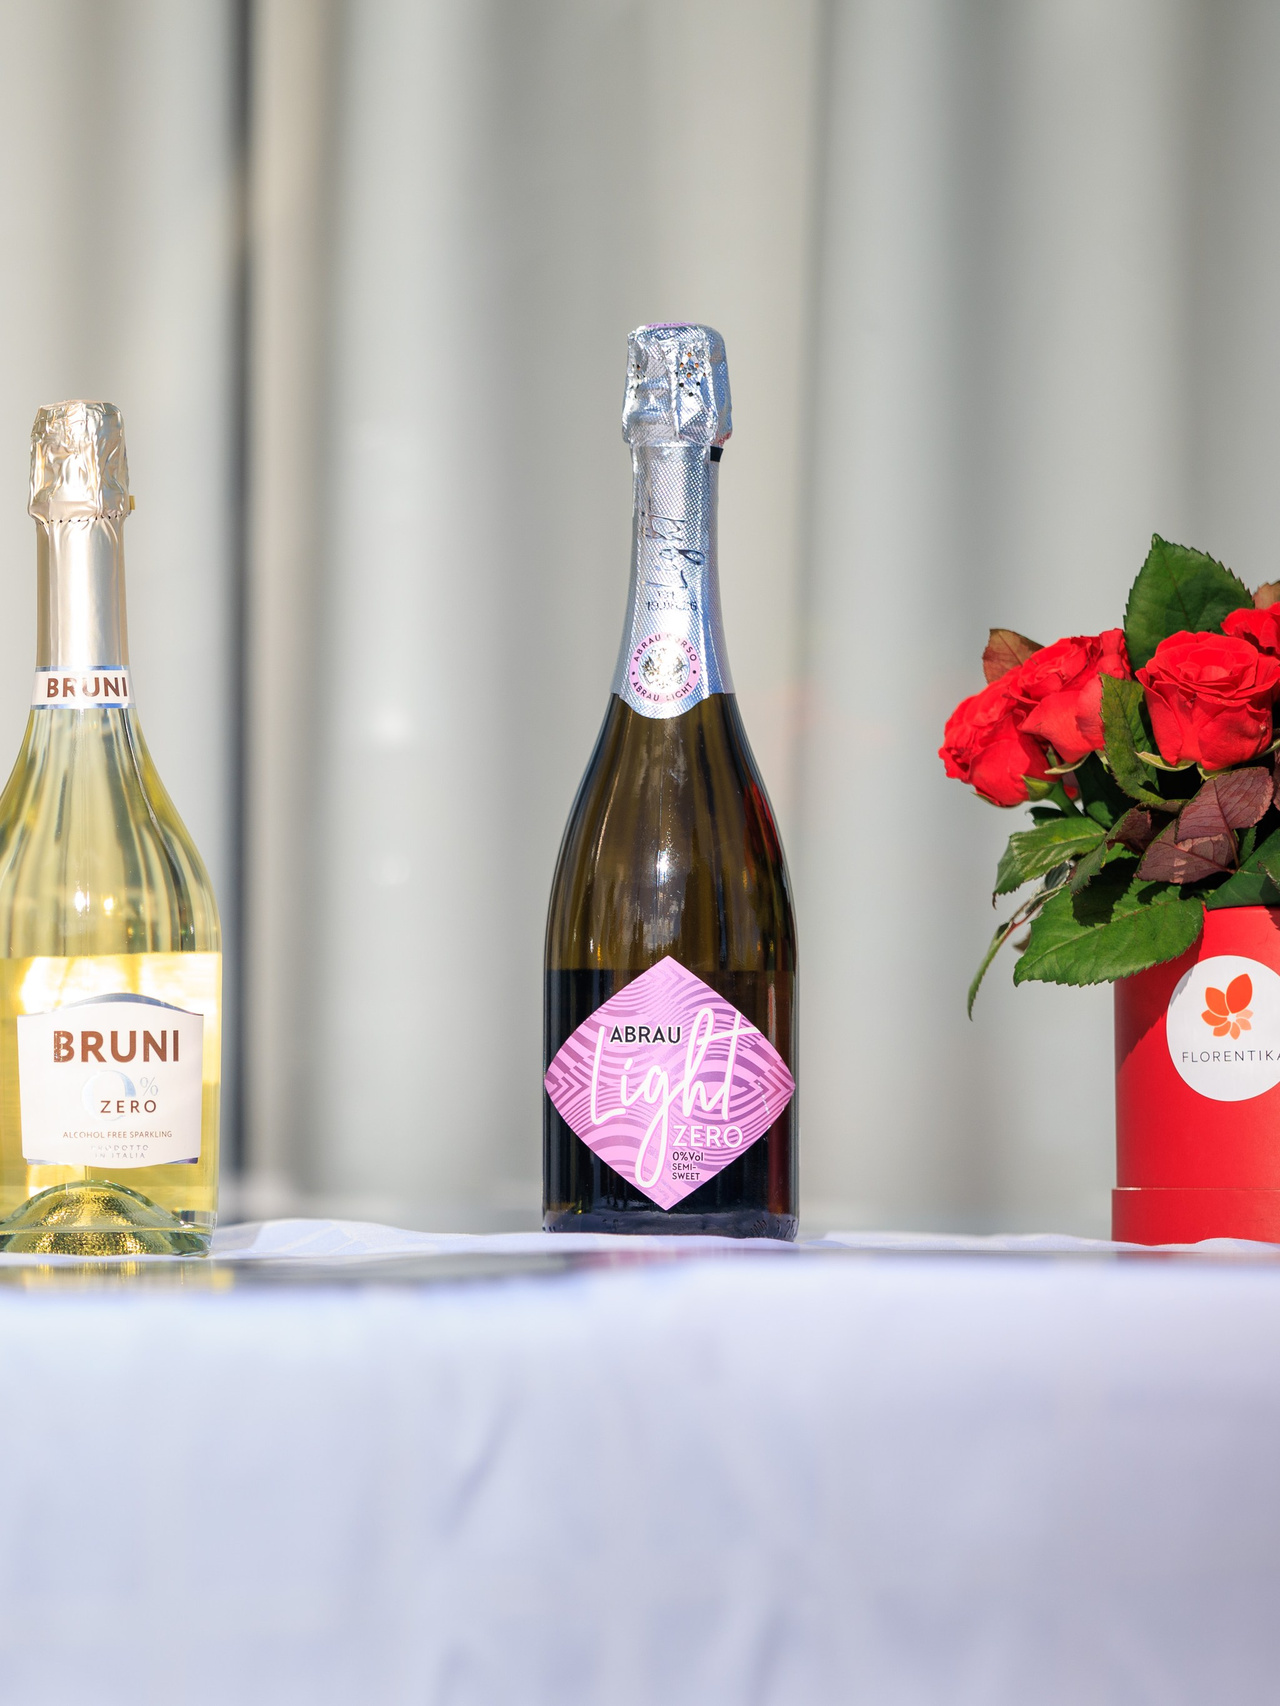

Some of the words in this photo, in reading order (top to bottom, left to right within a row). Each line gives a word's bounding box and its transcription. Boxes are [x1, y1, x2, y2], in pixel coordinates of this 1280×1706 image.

[633, 634, 661, 662] ABRAU
[666, 633, 697, 661] RSO
[47, 677, 128, 698] BRUNI
[632, 681, 660, 702] ABRAU
[610, 1026, 681, 1044] ABRAU
[53, 1030, 179, 1063] BRUNI
[100, 1100, 157, 1113] ZERO
[591, 1007, 764, 1189] Light
[63, 1131, 105, 1139] ALCOHOL
[107, 1131, 128, 1139] FREE
[129, 1130, 173, 1138] SPARKLING
[672, 1125, 743, 1148] ZERO
[672, 1151, 704, 1162] 0%Vol
[672, 1163, 697, 1171] SEMI-
[672, 1172, 701, 1181] SWEET
